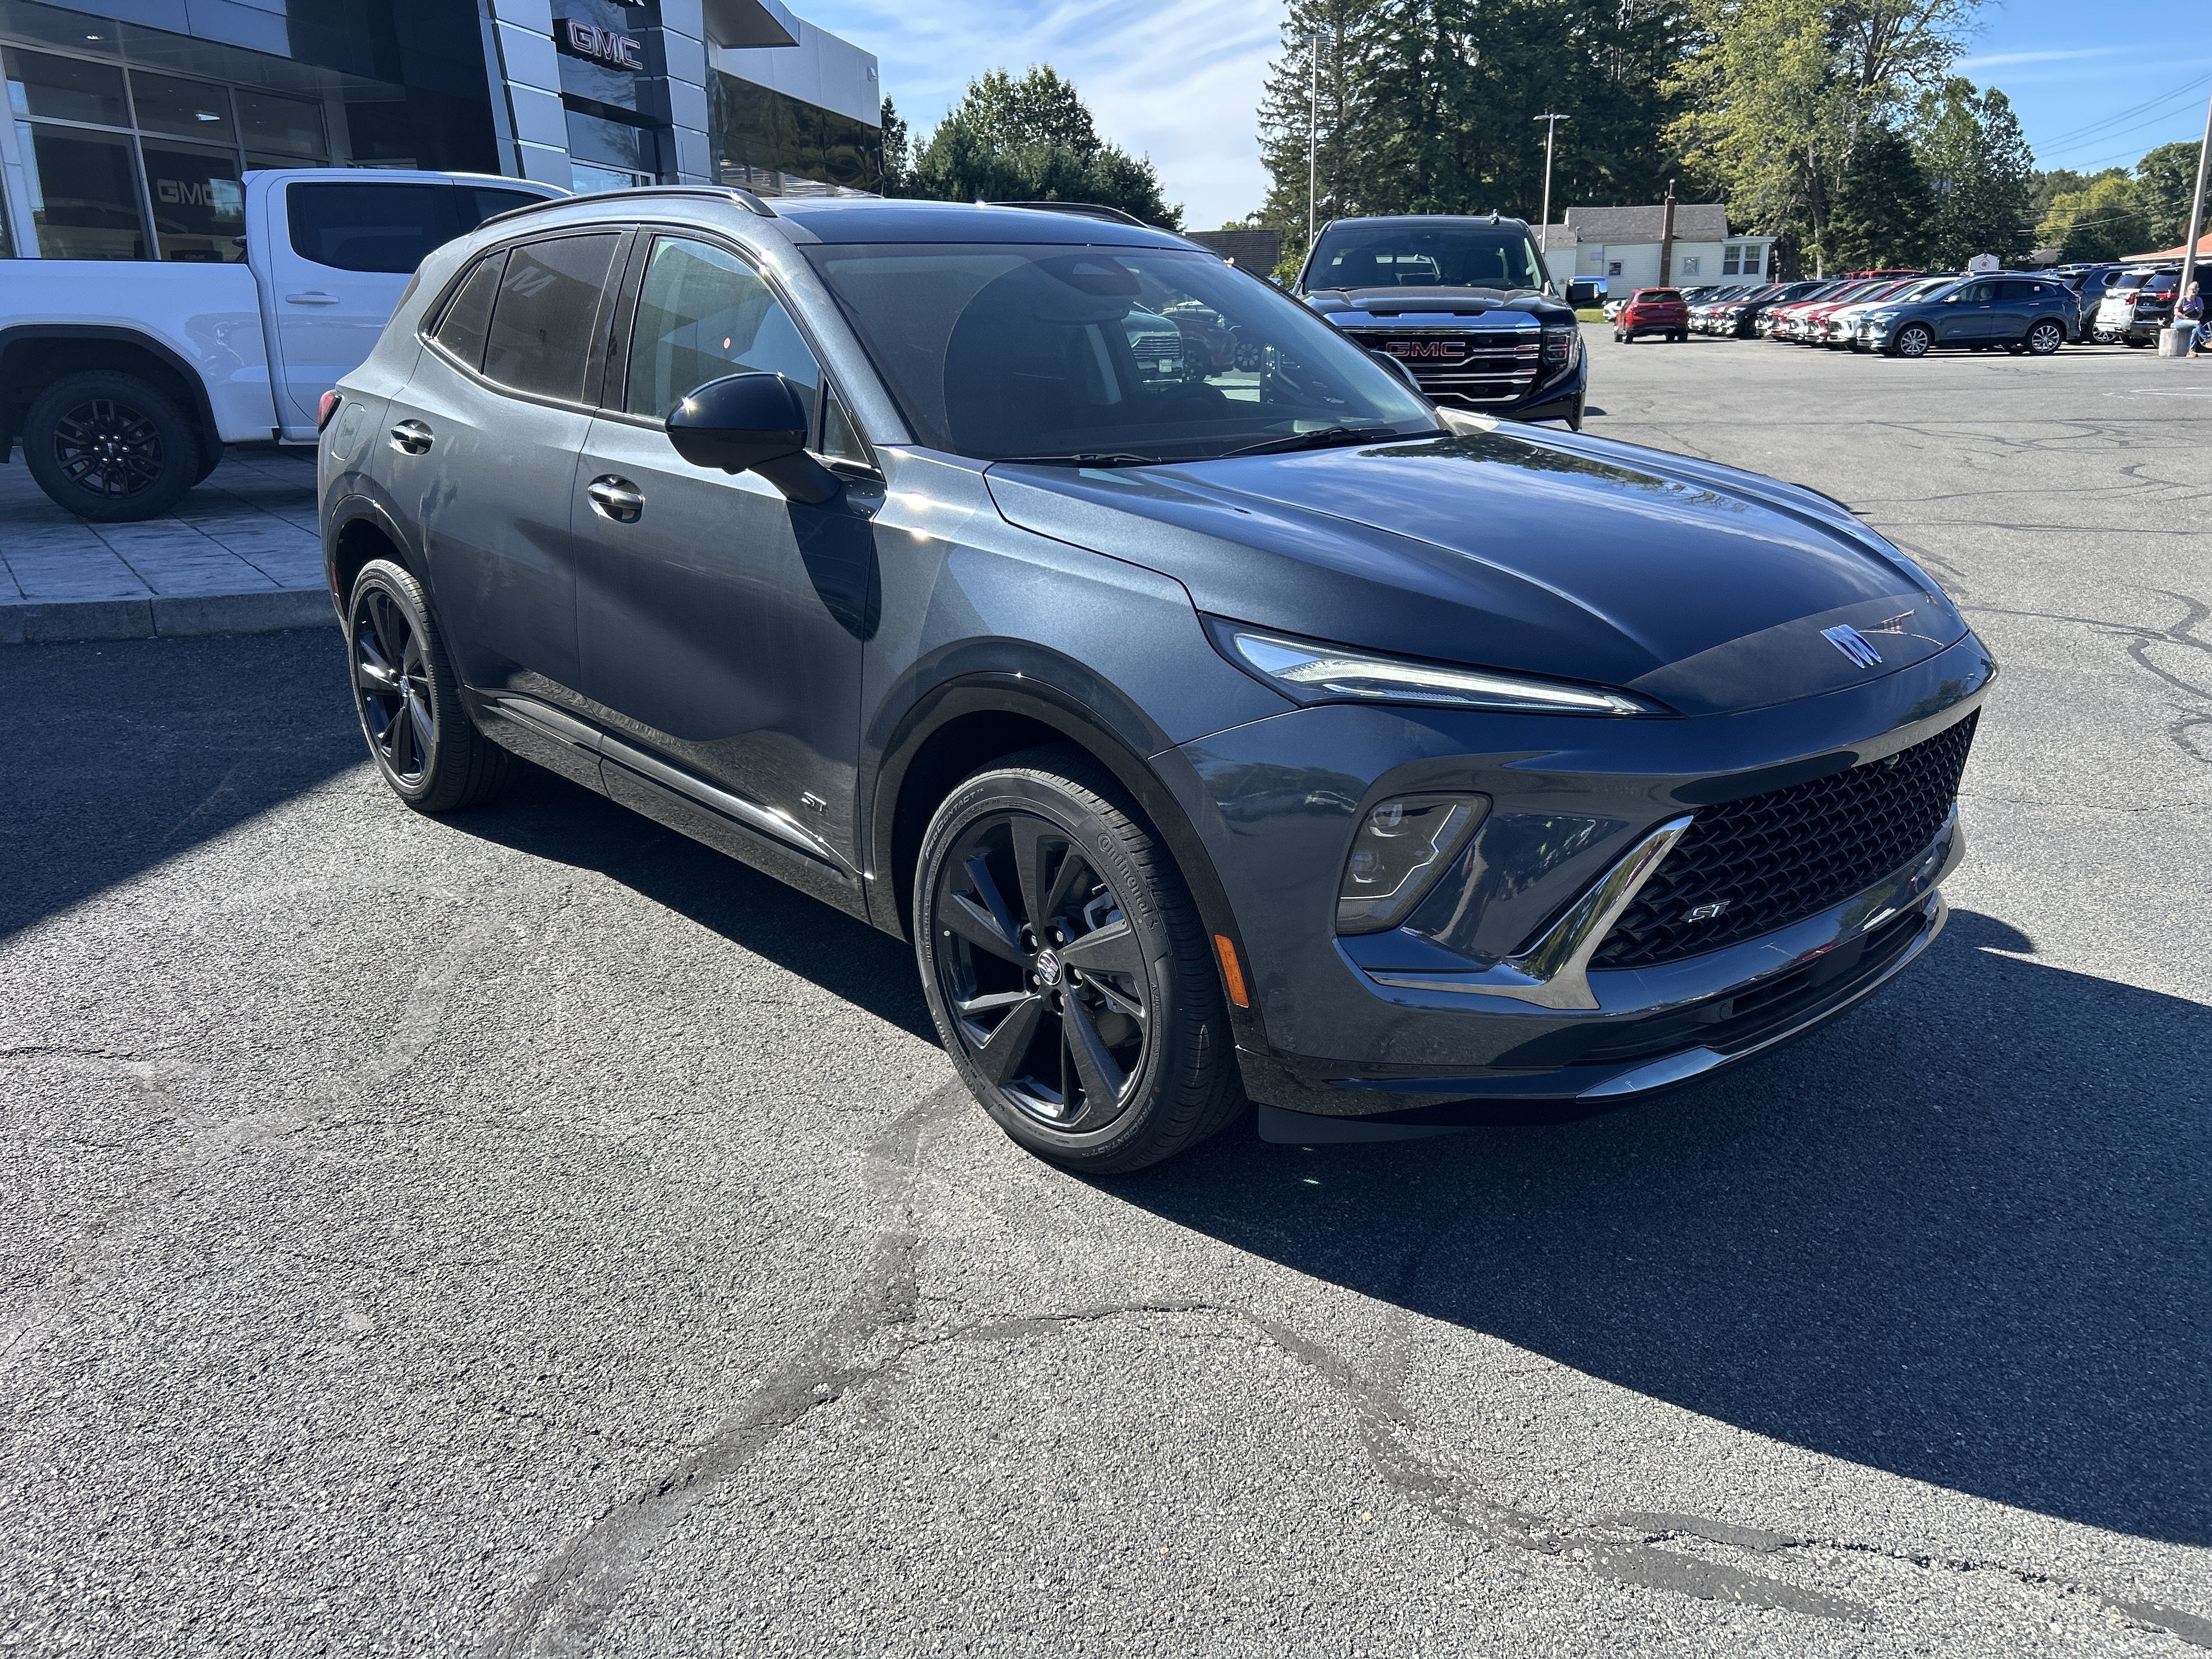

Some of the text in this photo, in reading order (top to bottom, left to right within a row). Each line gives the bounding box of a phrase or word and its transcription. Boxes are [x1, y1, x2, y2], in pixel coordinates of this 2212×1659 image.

[567, 18, 643, 70] GMC
[157, 179, 222, 207] GMC
[1386, 342, 1466, 357] GMC
[1097, 832, 1154, 917] Continental
